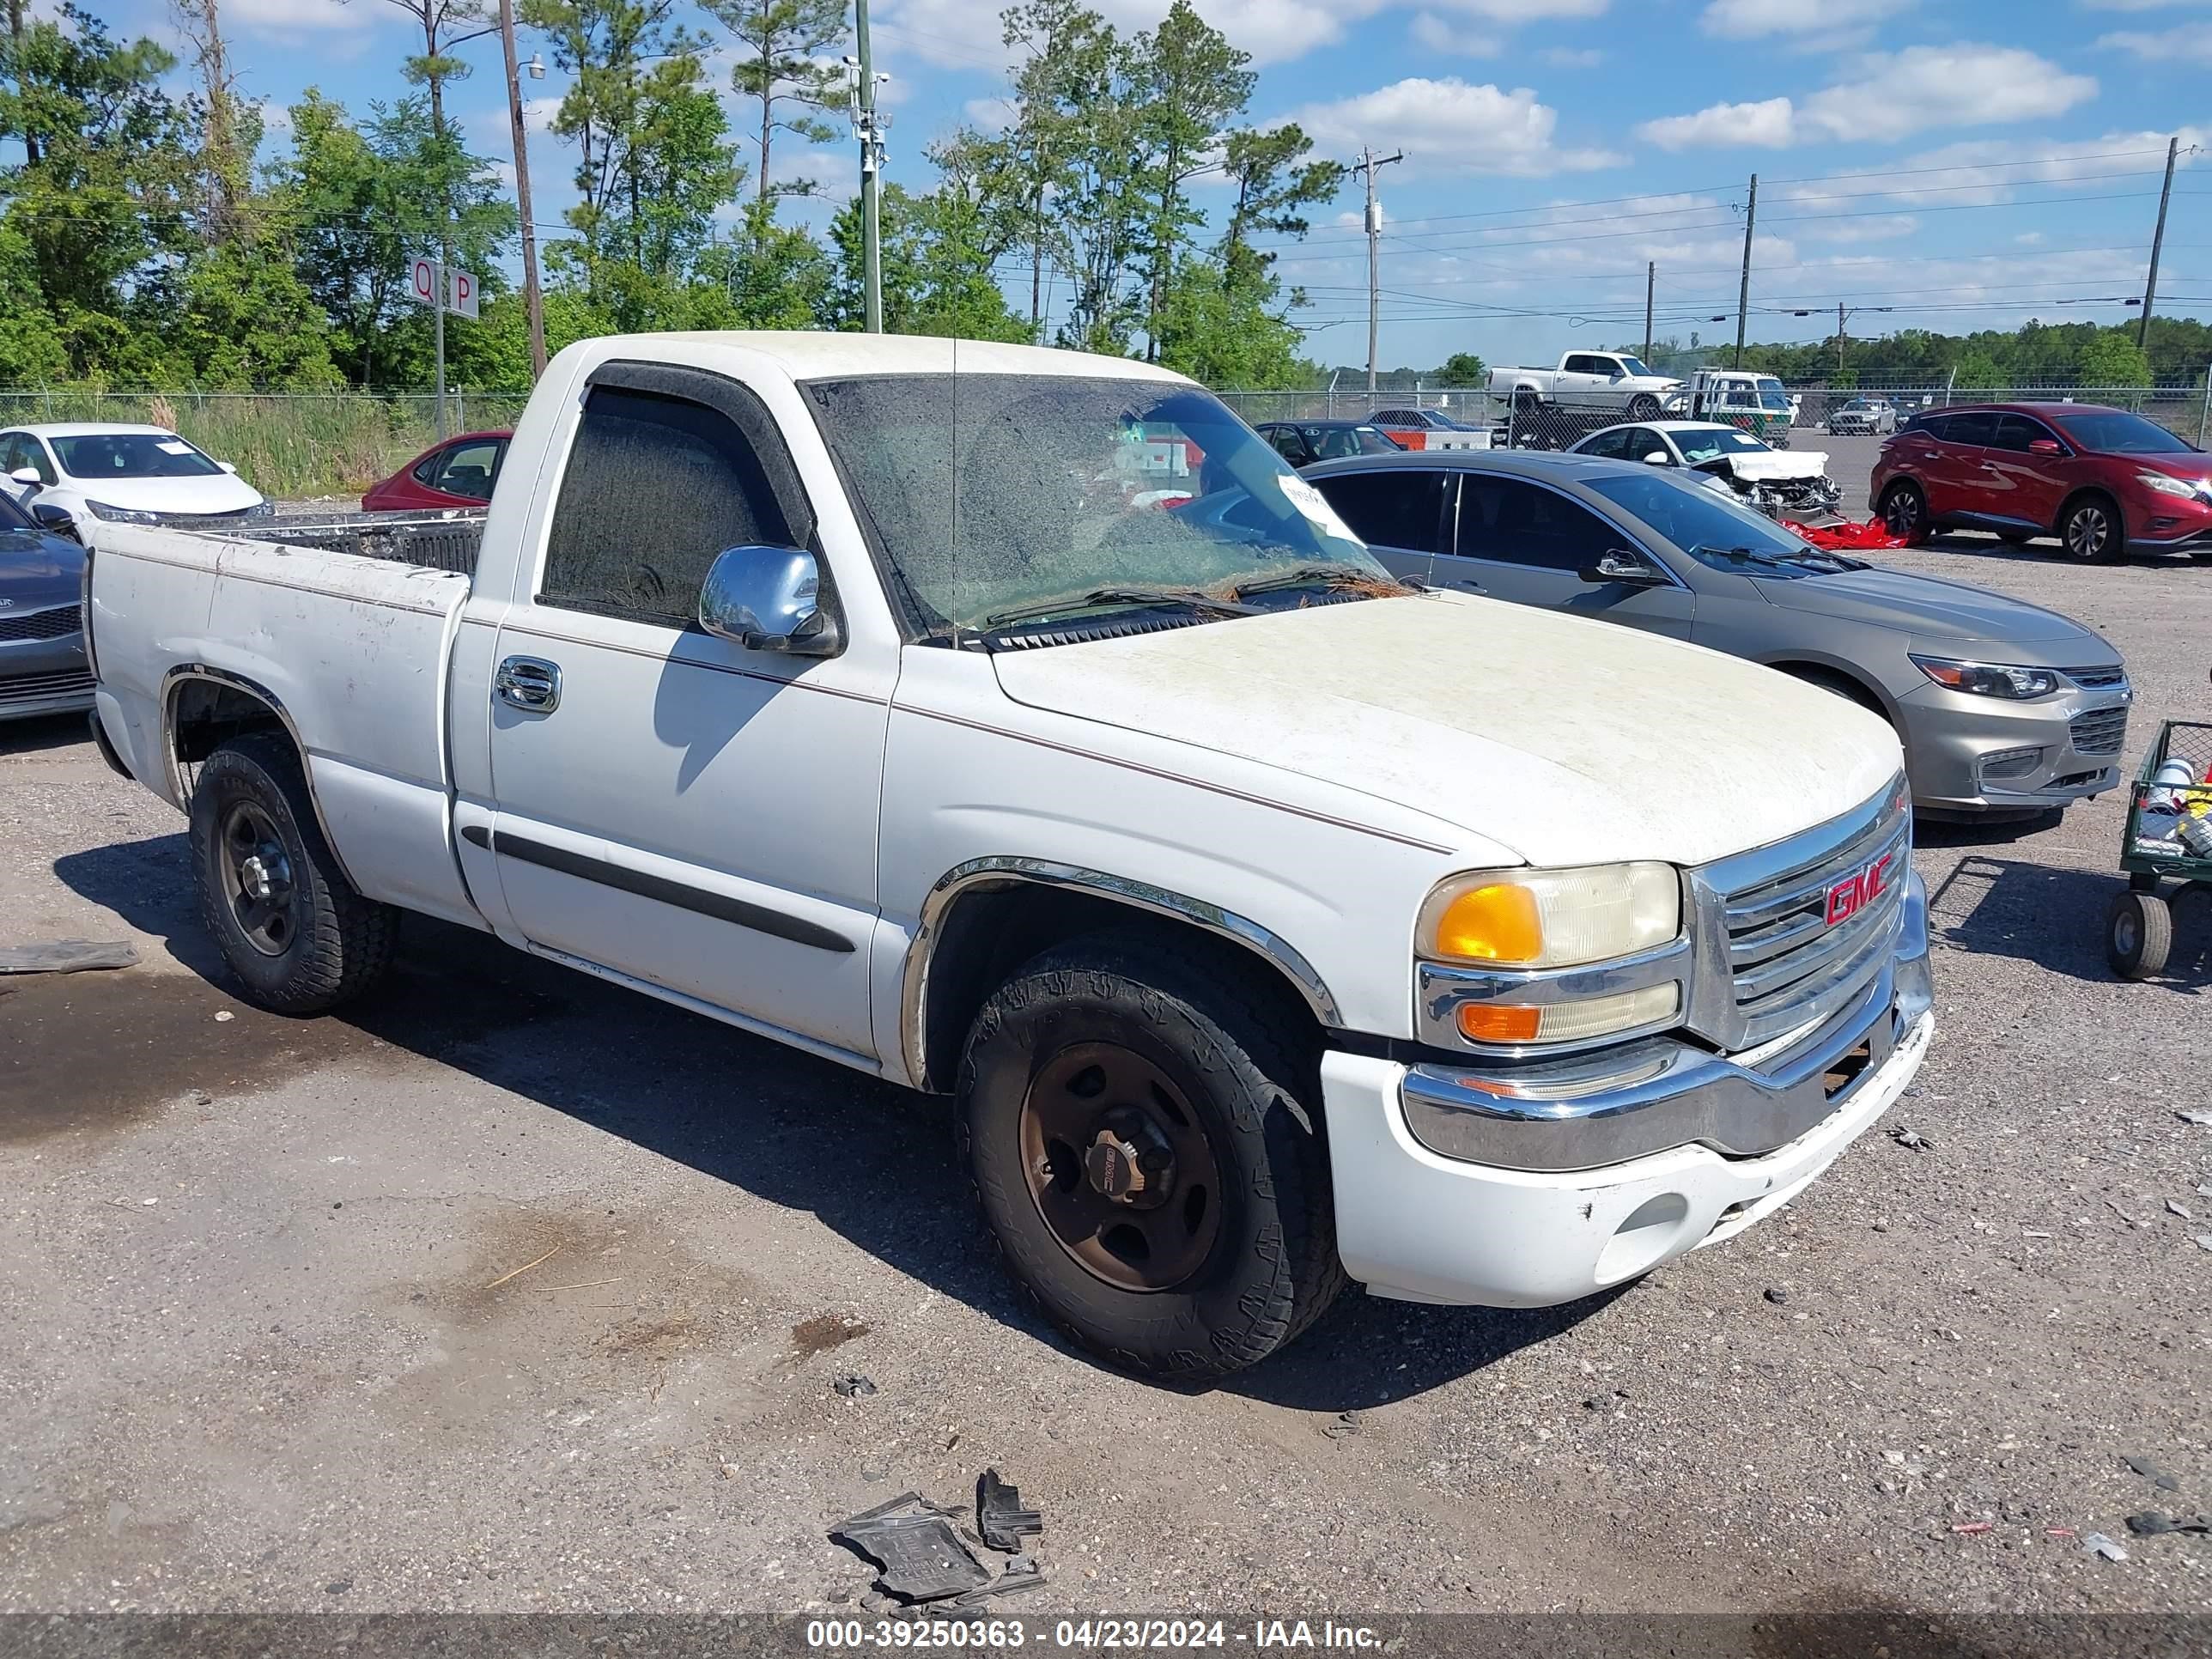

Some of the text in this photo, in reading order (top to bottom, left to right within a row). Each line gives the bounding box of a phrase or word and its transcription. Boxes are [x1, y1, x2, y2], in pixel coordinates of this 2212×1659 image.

[416, 262, 434, 302] Q
[459, 276, 470, 309] P
[1823, 853, 1893, 928] GMC
[1103, 1147, 1115, 1192] GMC
